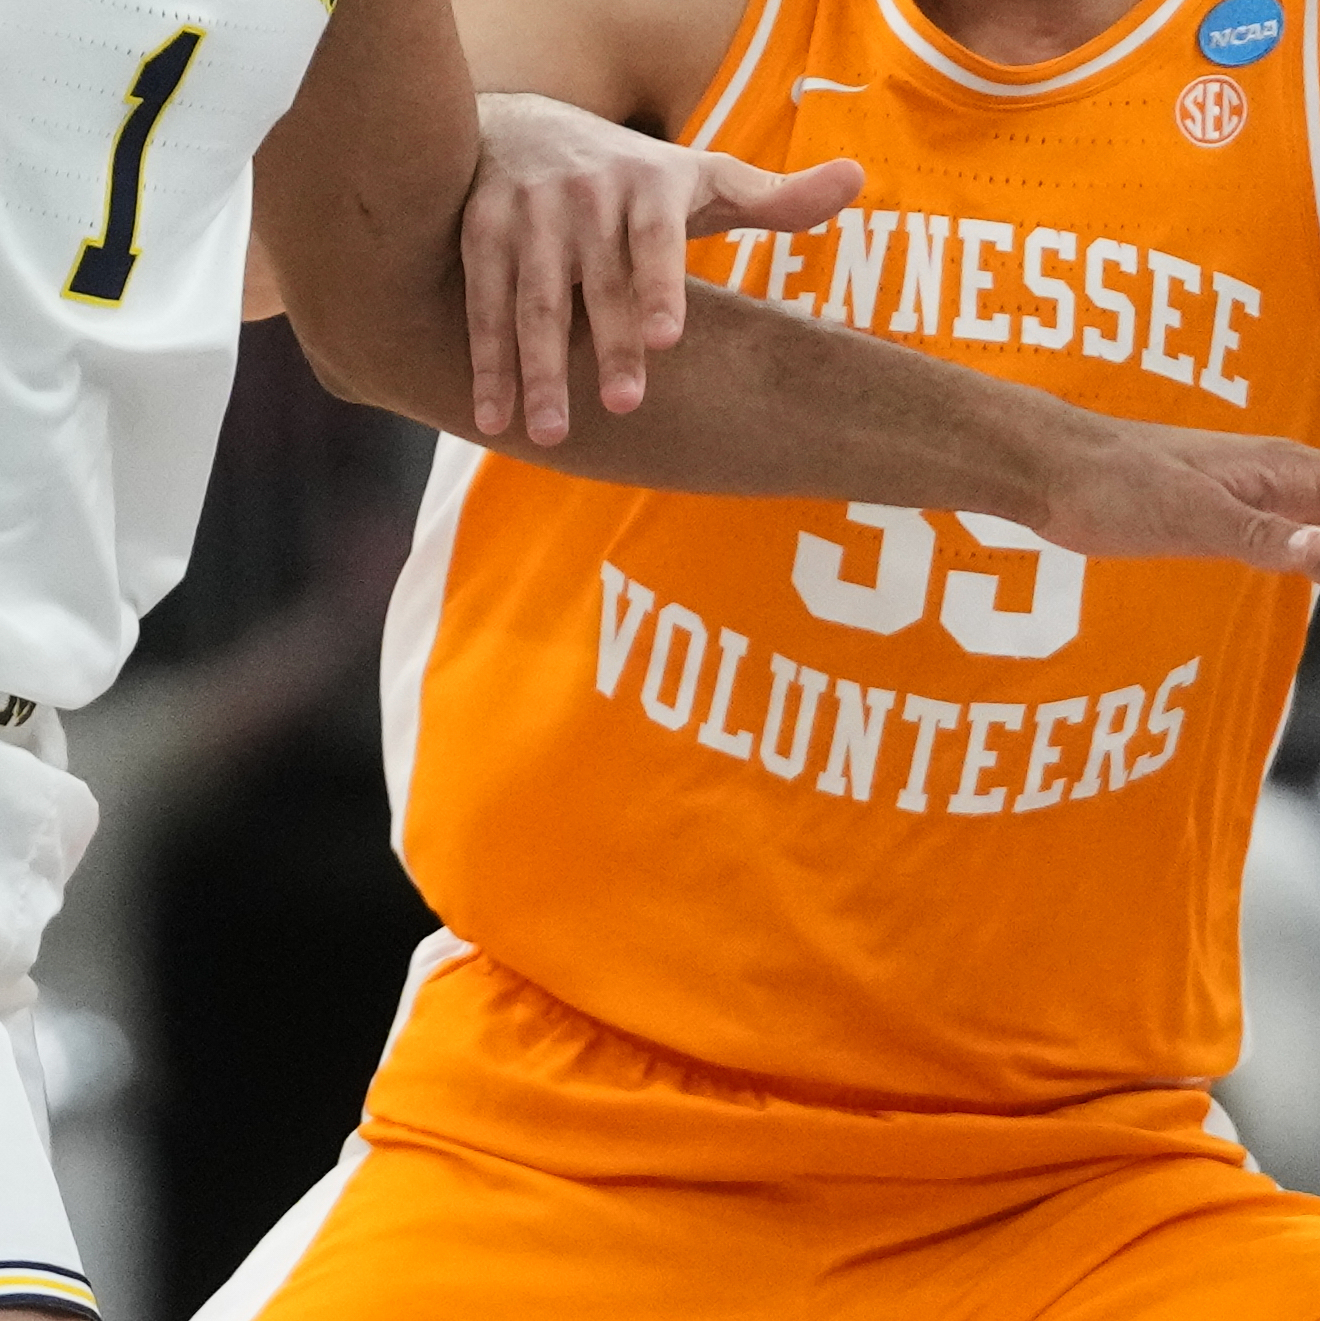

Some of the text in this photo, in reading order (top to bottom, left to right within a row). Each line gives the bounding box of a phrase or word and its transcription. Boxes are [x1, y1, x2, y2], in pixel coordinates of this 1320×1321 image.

[1184, 81, 1241, 140] SEC
[1209, 19, 1279, 48] NCAA
[61, 25, 207, 307] 1
[596, 560, 1201, 816] VOLUNTEERS
